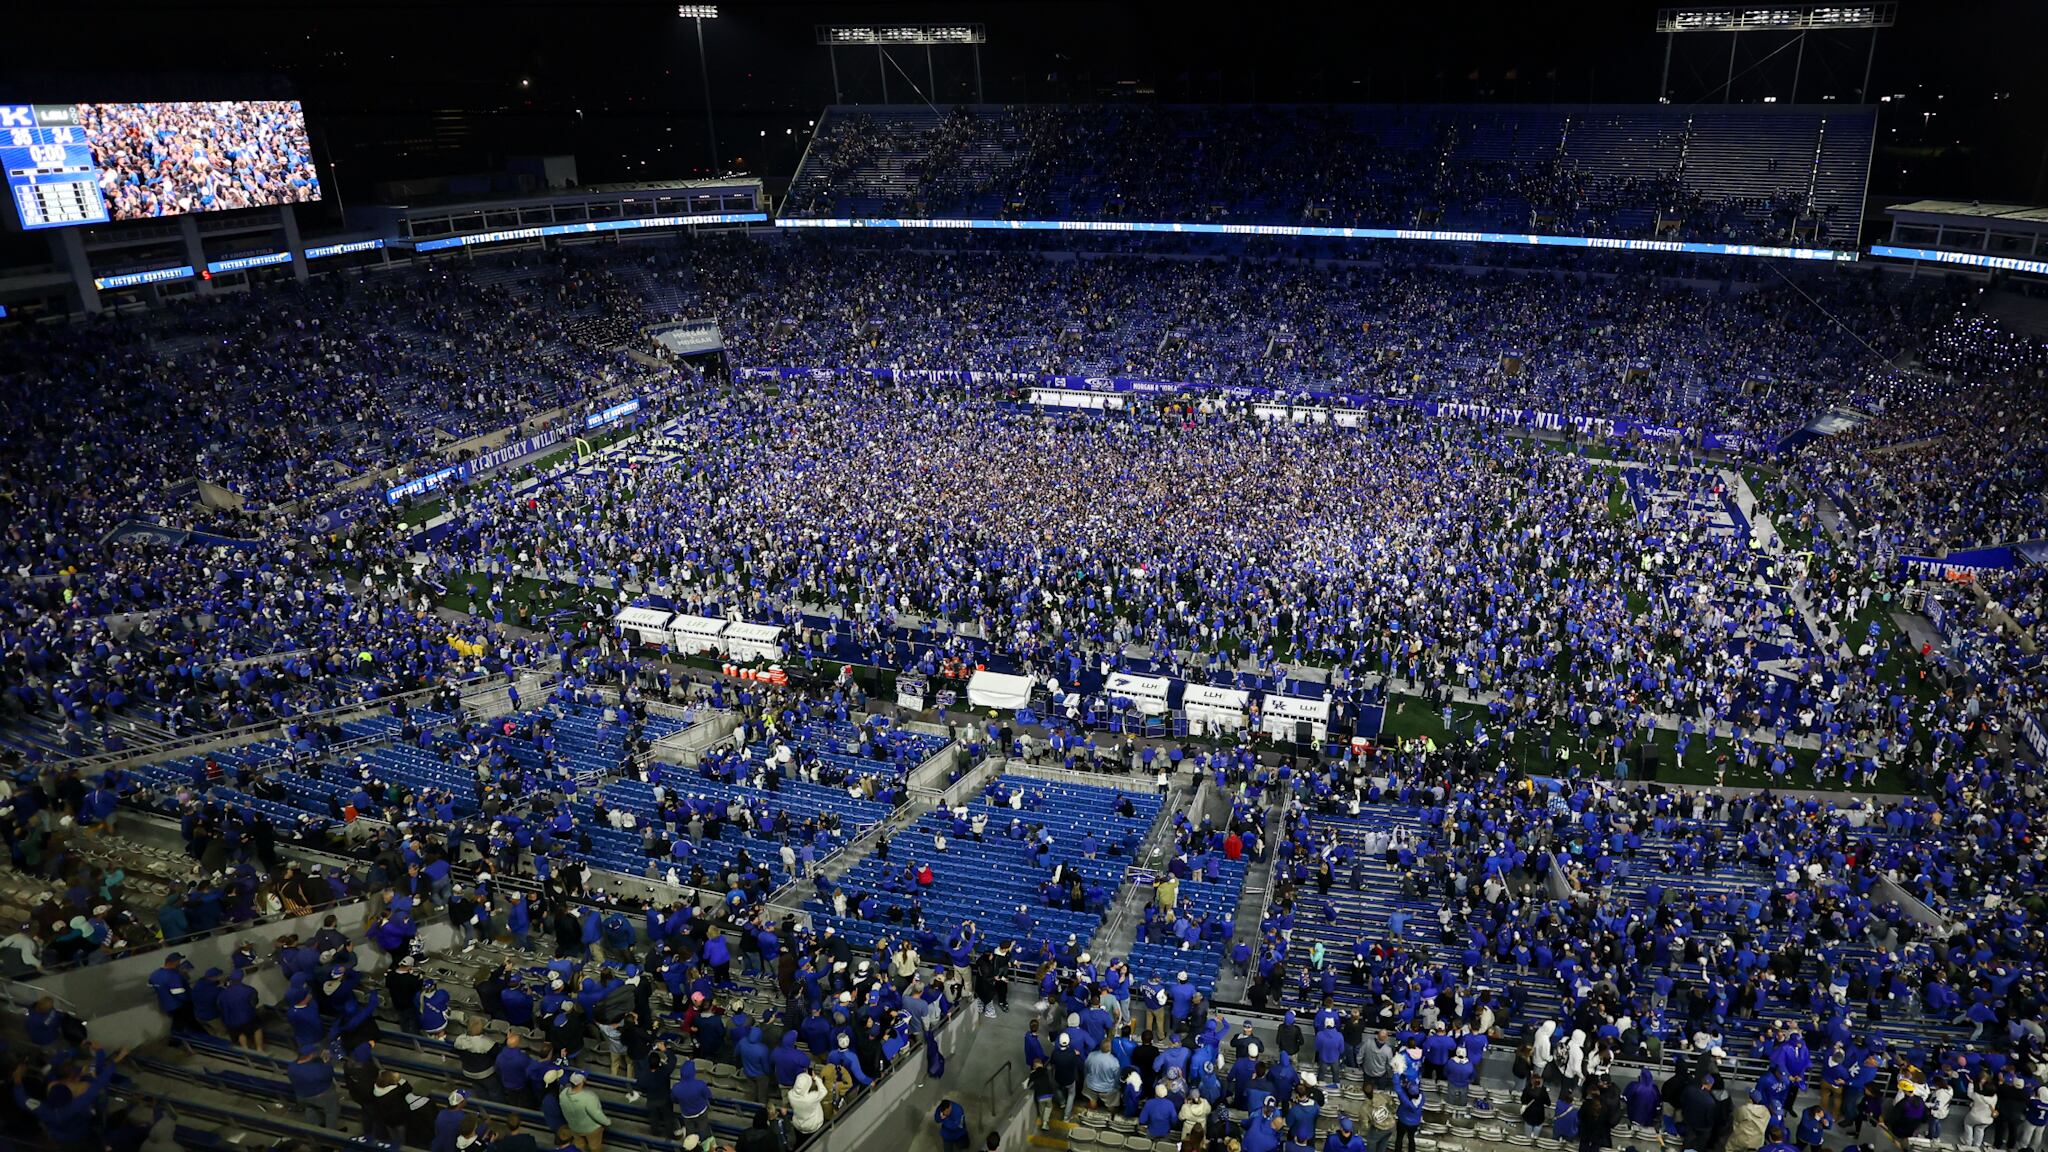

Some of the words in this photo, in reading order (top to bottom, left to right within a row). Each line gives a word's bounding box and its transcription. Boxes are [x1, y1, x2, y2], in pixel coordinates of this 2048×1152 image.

[52, 128, 74, 144] 34
[30, 145, 67, 162] 0:00
[640, 216, 675, 227] VICTORY
[896, 219, 930, 228] VICTORY
[1058, 221, 1090, 230] VICTORY
[1222, 225, 1256, 233] VICTORY
[1396, 229, 1433, 240] VICTORY
[461, 233, 496, 245] VICTORY
[1587, 237, 1627, 249] VICTORY
[1936, 251, 1985, 266] VICTORY
[220, 259, 247, 270] VICTORY
[108, 275, 142, 286] VICTORY
[1534, 407, 1615, 437] WILCATS
[632, 612, 655, 621] LIVE
[686, 620, 708, 629] LIFE
[1203, 691, 1222, 699] LLH
[1300, 704, 1317, 712] LLH
